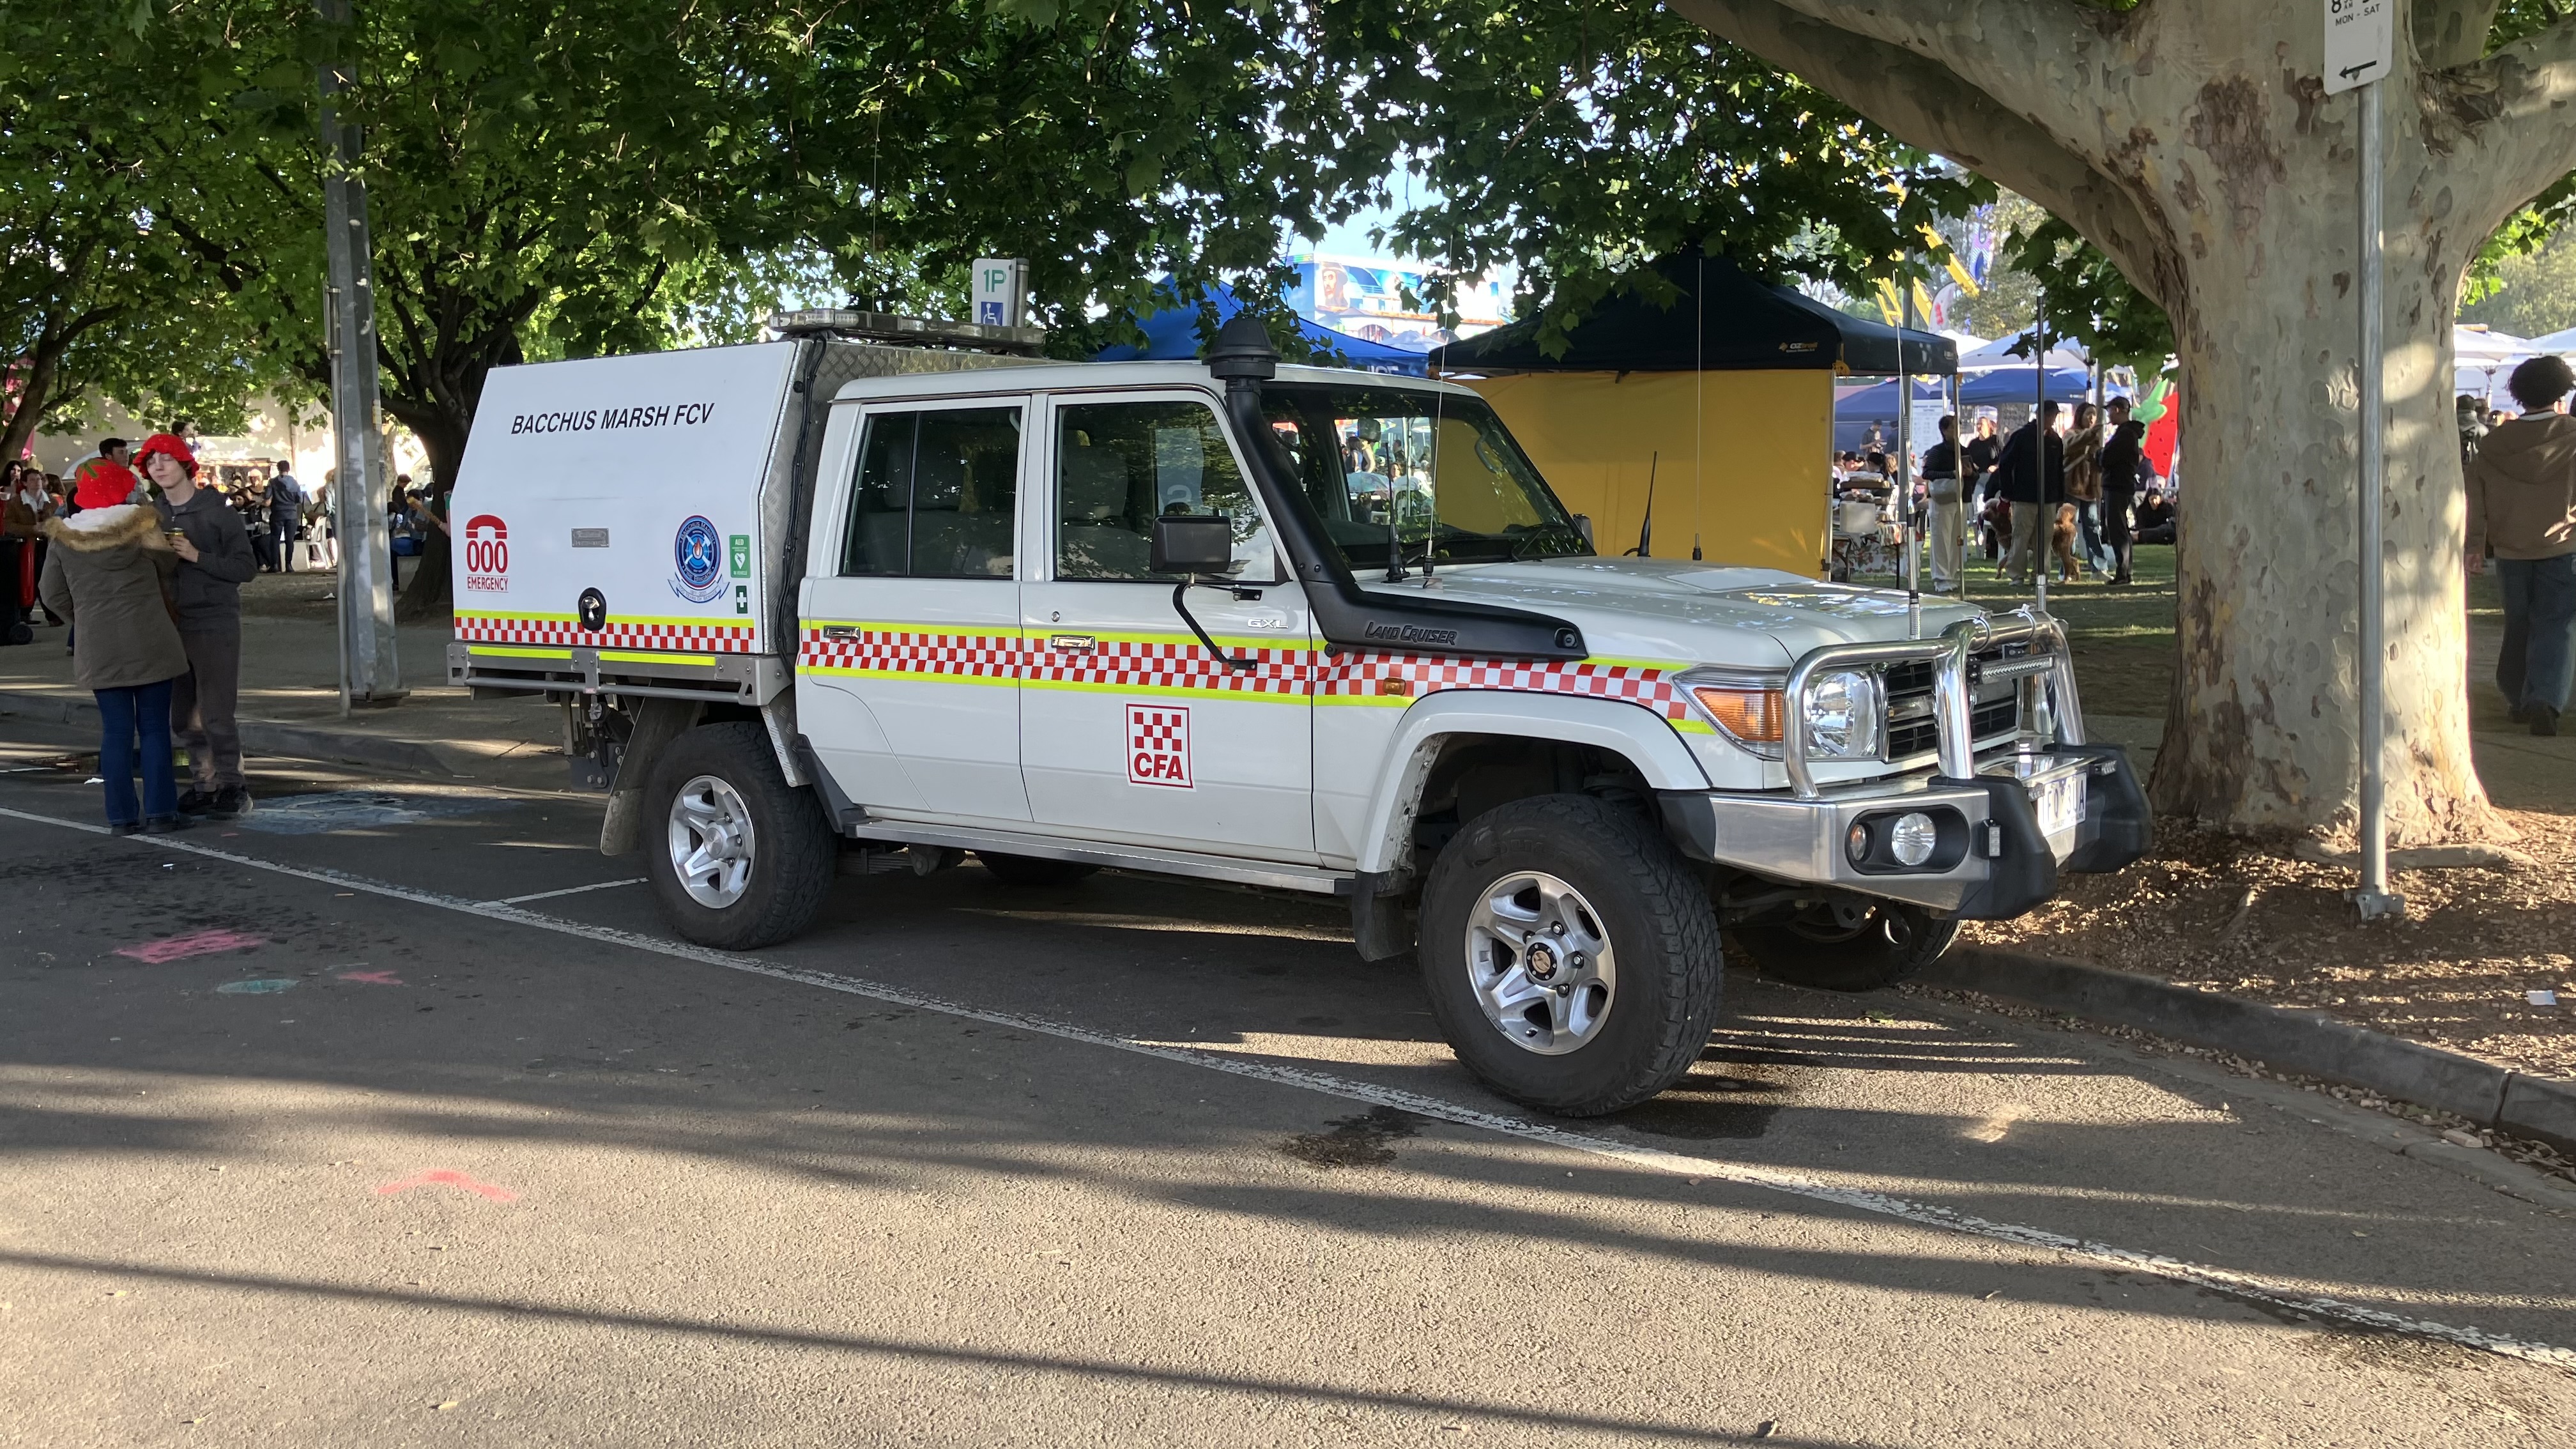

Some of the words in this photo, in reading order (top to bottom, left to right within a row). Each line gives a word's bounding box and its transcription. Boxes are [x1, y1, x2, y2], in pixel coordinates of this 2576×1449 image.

[2335, 13, 2354, 26] MON
[2364, 3, 2380, 17] SAT
[983, 269, 1007, 293] 1P
[510, 410, 597, 435] BACCHUS
[601, 405, 671, 429] MARSH
[673, 402, 715, 425] FCV
[466, 540, 509, 574] 000
[467, 576, 509, 591] EMERGENCY
[1247, 618, 1289, 629] GXL
[1365, 622, 1400, 640] LAND
[1400, 625, 1457, 646] CRUISER
[1133, 752, 1184, 780] CFA
